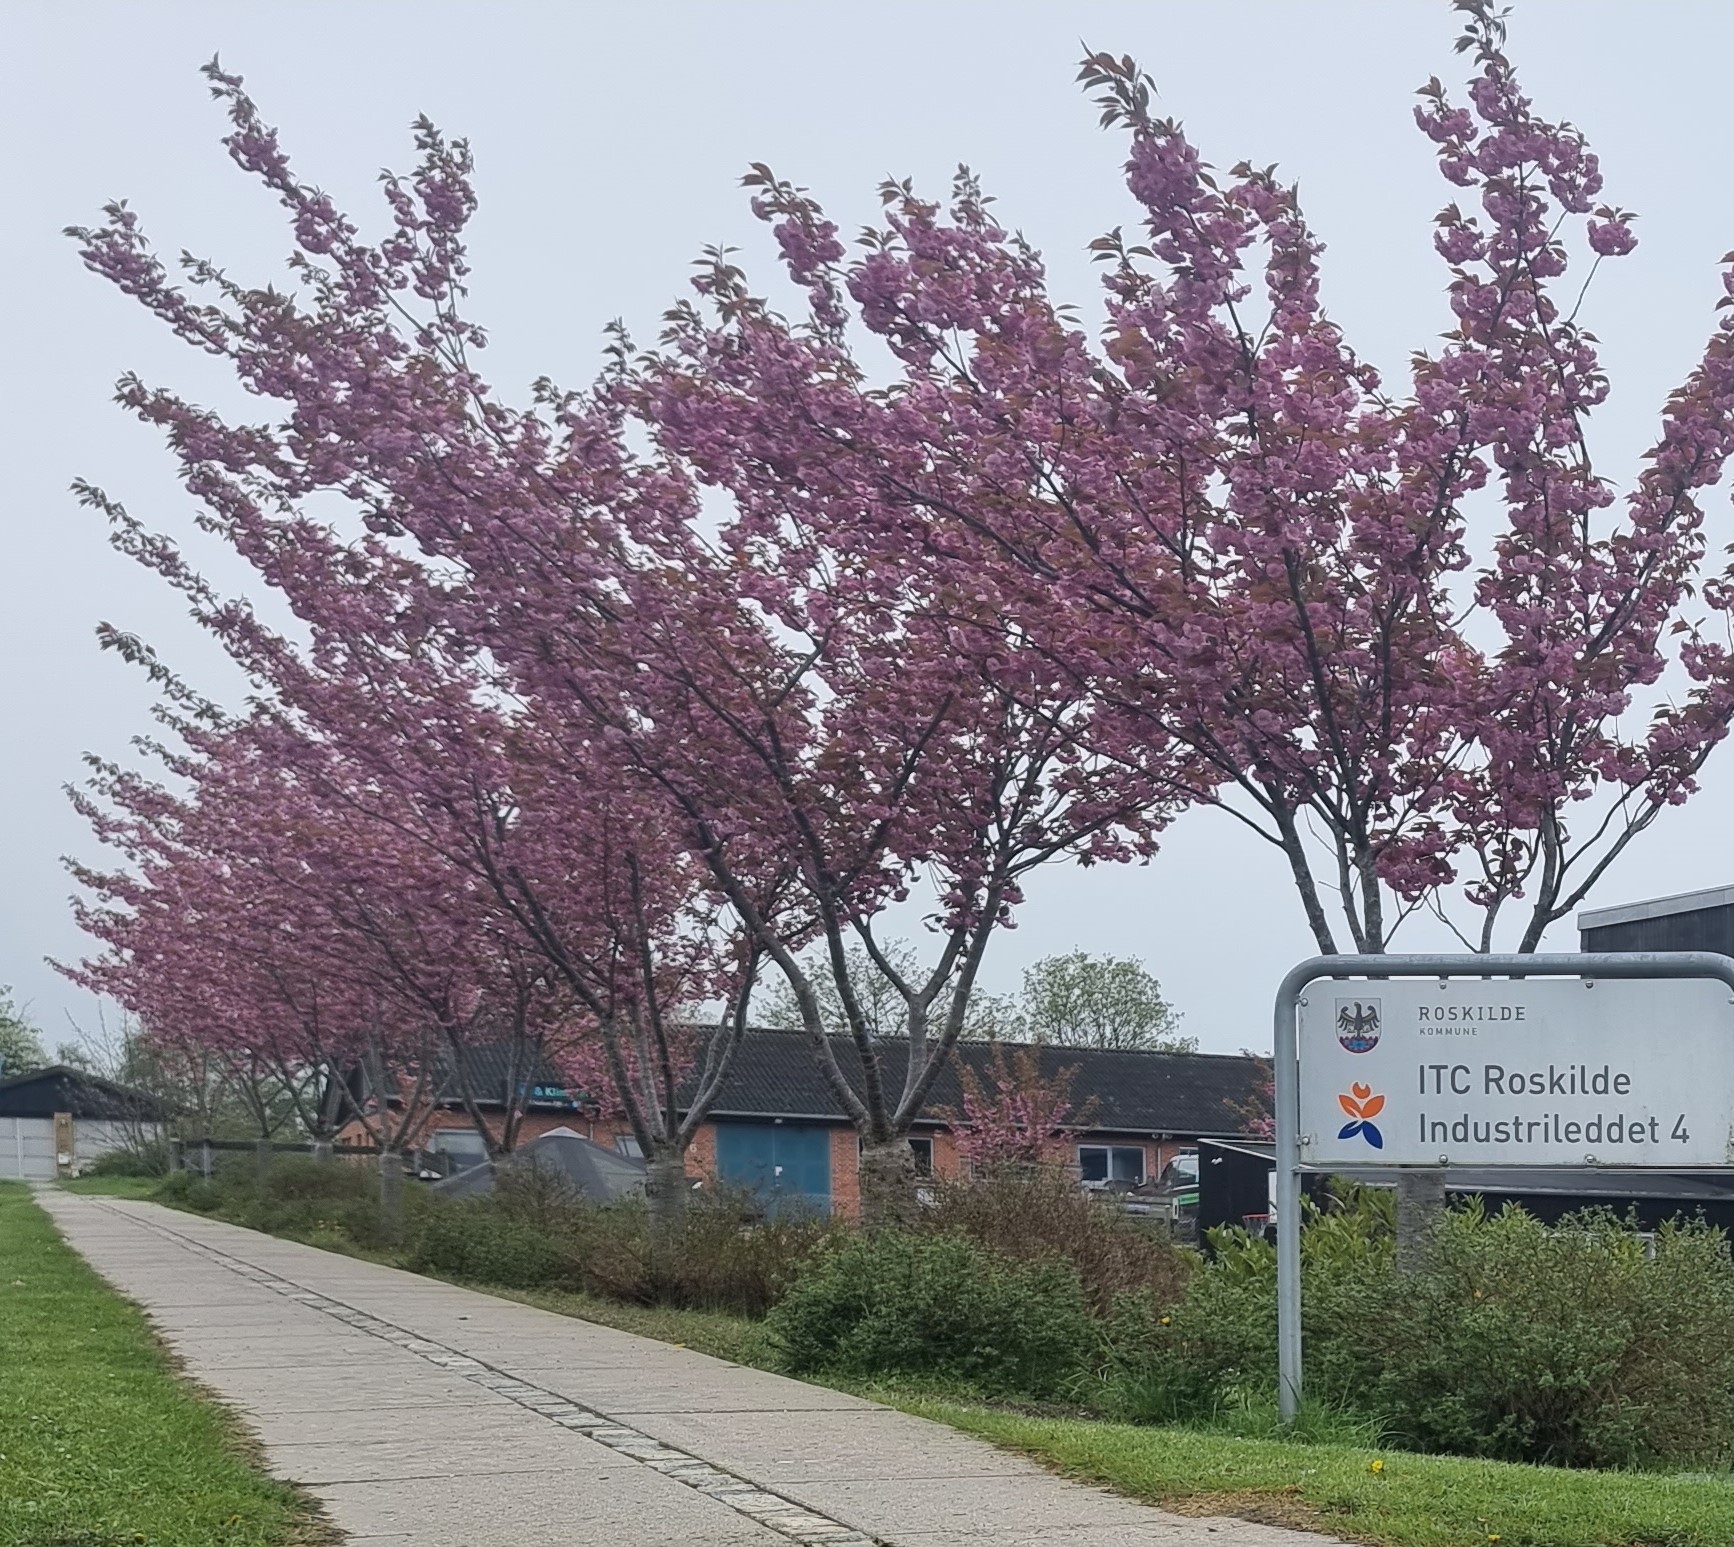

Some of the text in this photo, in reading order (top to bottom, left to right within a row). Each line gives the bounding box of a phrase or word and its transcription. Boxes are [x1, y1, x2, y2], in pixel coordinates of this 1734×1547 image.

[1418, 1006, 1526, 1021] ROSKILDE
[1419, 1027, 1478, 1036] KOMMUNE
[1419, 1064, 1631, 1096] ITC Roskilde
[1419, 1112, 1690, 1144] Industrileddet 4
